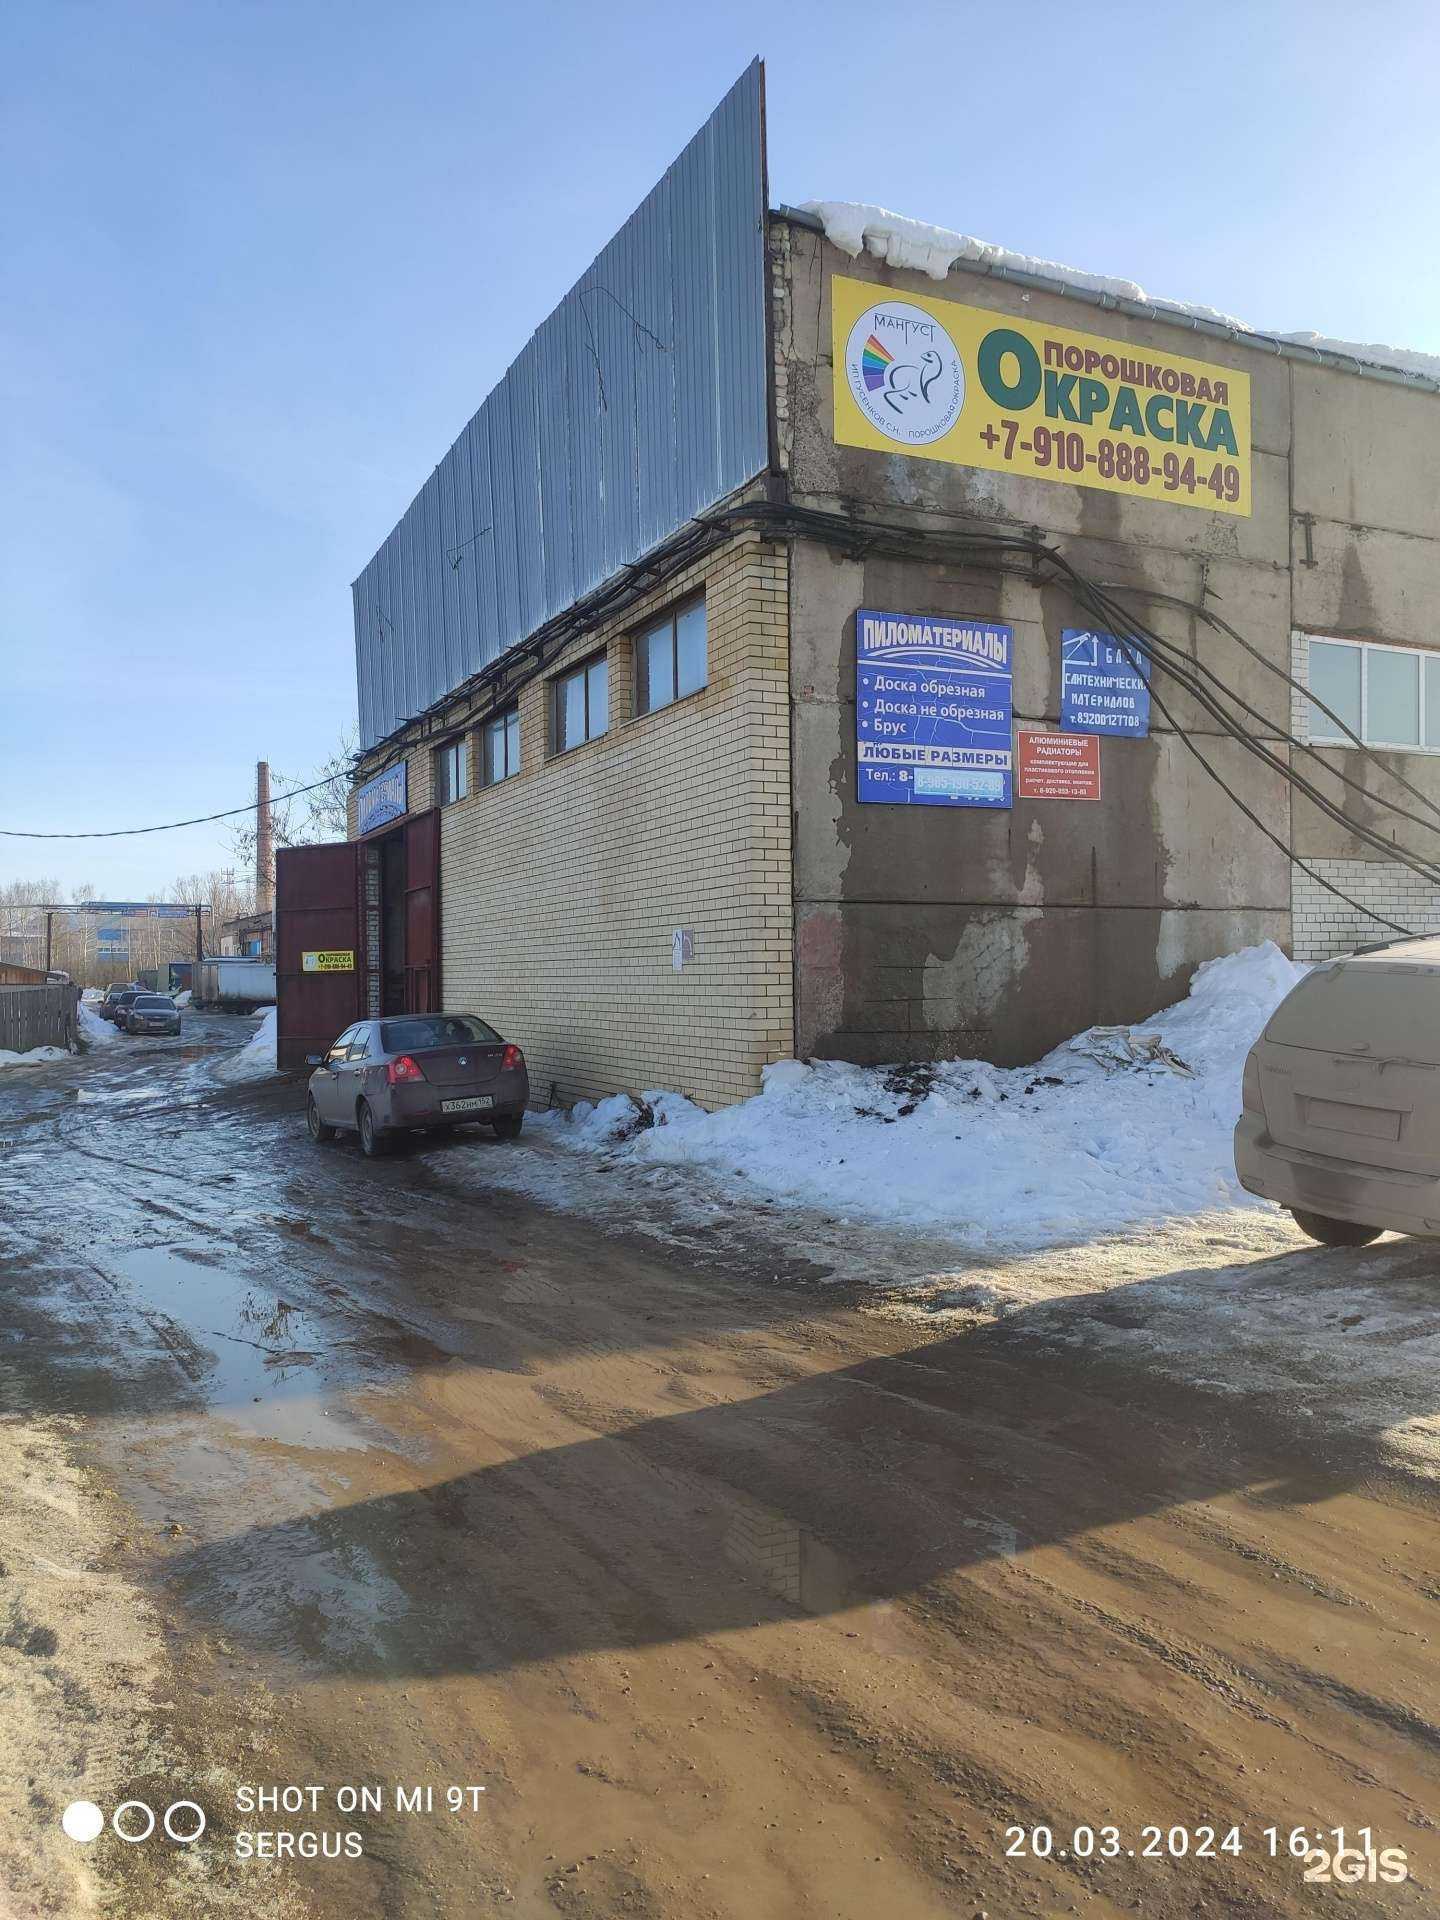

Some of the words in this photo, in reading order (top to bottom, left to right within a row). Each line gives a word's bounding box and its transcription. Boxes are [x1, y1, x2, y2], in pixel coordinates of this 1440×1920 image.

[874, 313, 936, 344] МАНГУСТ
[1044, 340, 1228, 405] ПОРОШКОВАЯ
[908, 404, 955, 439] ПОРОШКОВАЯ
[952, 360, 961, 405] ОКРАСКА
[977, 328, 1239, 456] ОКРАСКА
[980, 420, 1240, 502] +7-910-888-94-49
[863, 619, 1007, 664] ПИЛОМАТЕРИАЛЫ
[874, 676, 916, 691] Доска
[921, 680, 986, 698] обрезная
[874, 699, 916, 714] Доска
[921, 706, 937, 716] не
[941, 704, 1004, 721] обрезная
[1071, 693, 1135, 708] МАТЕРИАЛОВ
[874, 719, 907, 735] Брус
[1029, 737, 1089, 747] АЛЮМИНИЕВЫЕ
[1036, 747, 1082, 756] РАДИАТОРЫ
[863, 745, 925, 761] ЛЮБЫЕ
[931, 751, 1007, 765] РАЗМЕРЫ
[866, 769, 895, 782] Тел.:
